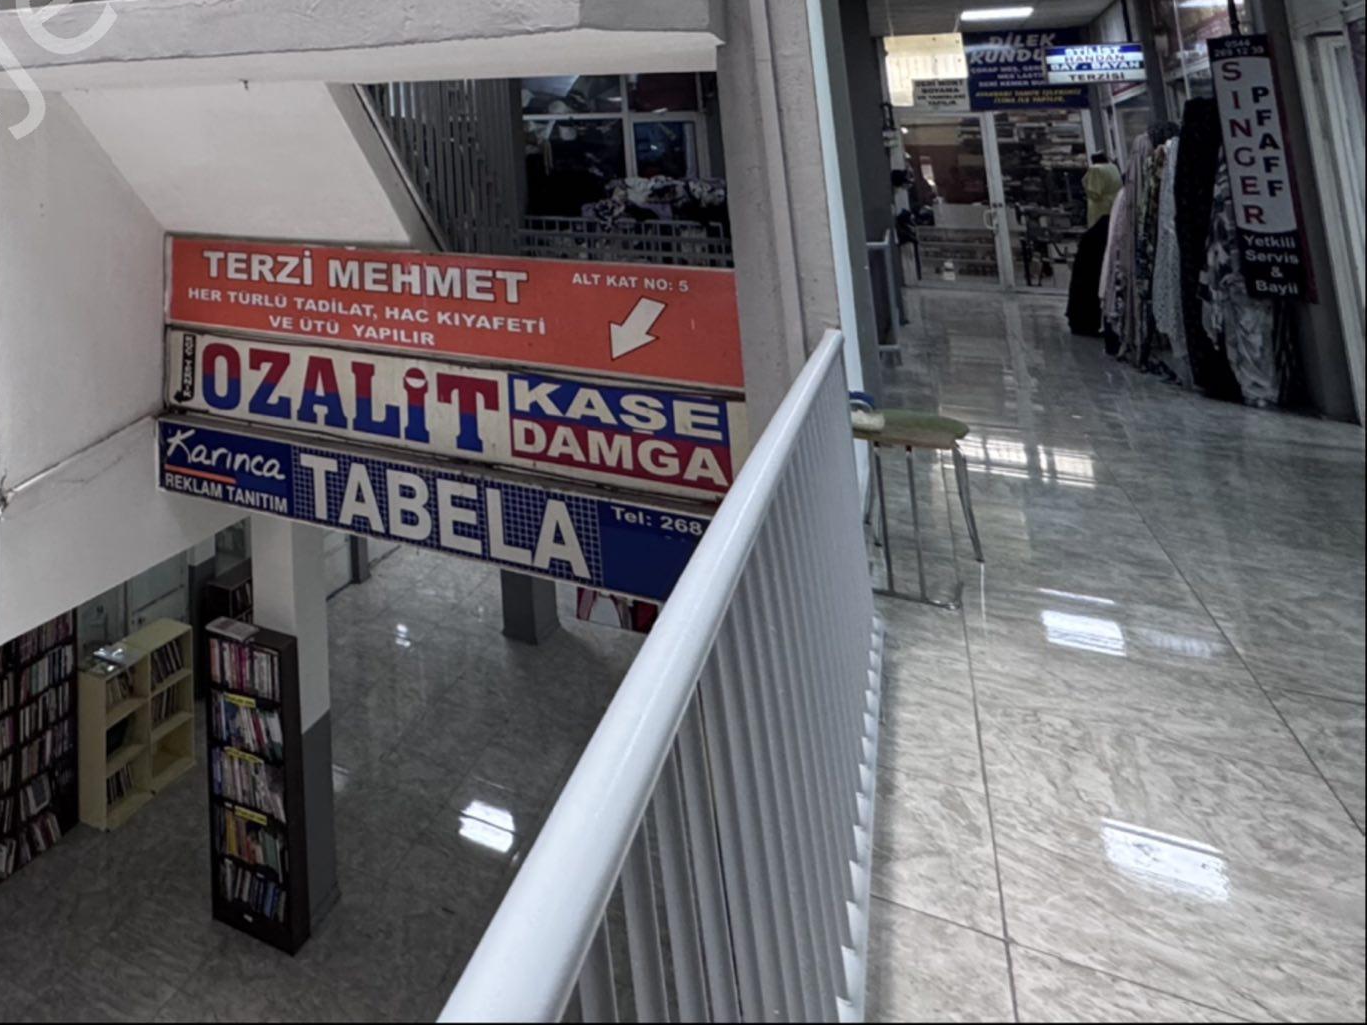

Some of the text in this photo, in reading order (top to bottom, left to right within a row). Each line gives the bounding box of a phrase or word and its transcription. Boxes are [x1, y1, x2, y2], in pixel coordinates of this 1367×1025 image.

[988, 32, 1056, 48] DİLEK
[1221, 60, 1266, 226] SINGER
[1251, 86, 1283, 198] PFAFF
[1243, 234, 1296, 249] Yetkili
[1244, 249, 1300, 264] Servis
[202, 249, 529, 304] TERZİ MEHMET
[572, 272, 689, 293] ALT KAT NO: 5
[1270, 267, 1284, 278] &
[188, 287, 222, 303] HER
[437, 310, 546, 336] KIYAFETİ
[269, 314, 293, 330] VE
[352, 323, 435, 346] YAPILIR
[512, 418, 729, 487] DAMGA
[165, 472, 289, 514] REKLAM TANITIM
[298, 453, 592, 581] TABELA
[610, 505, 704, 537] Tel: 268
